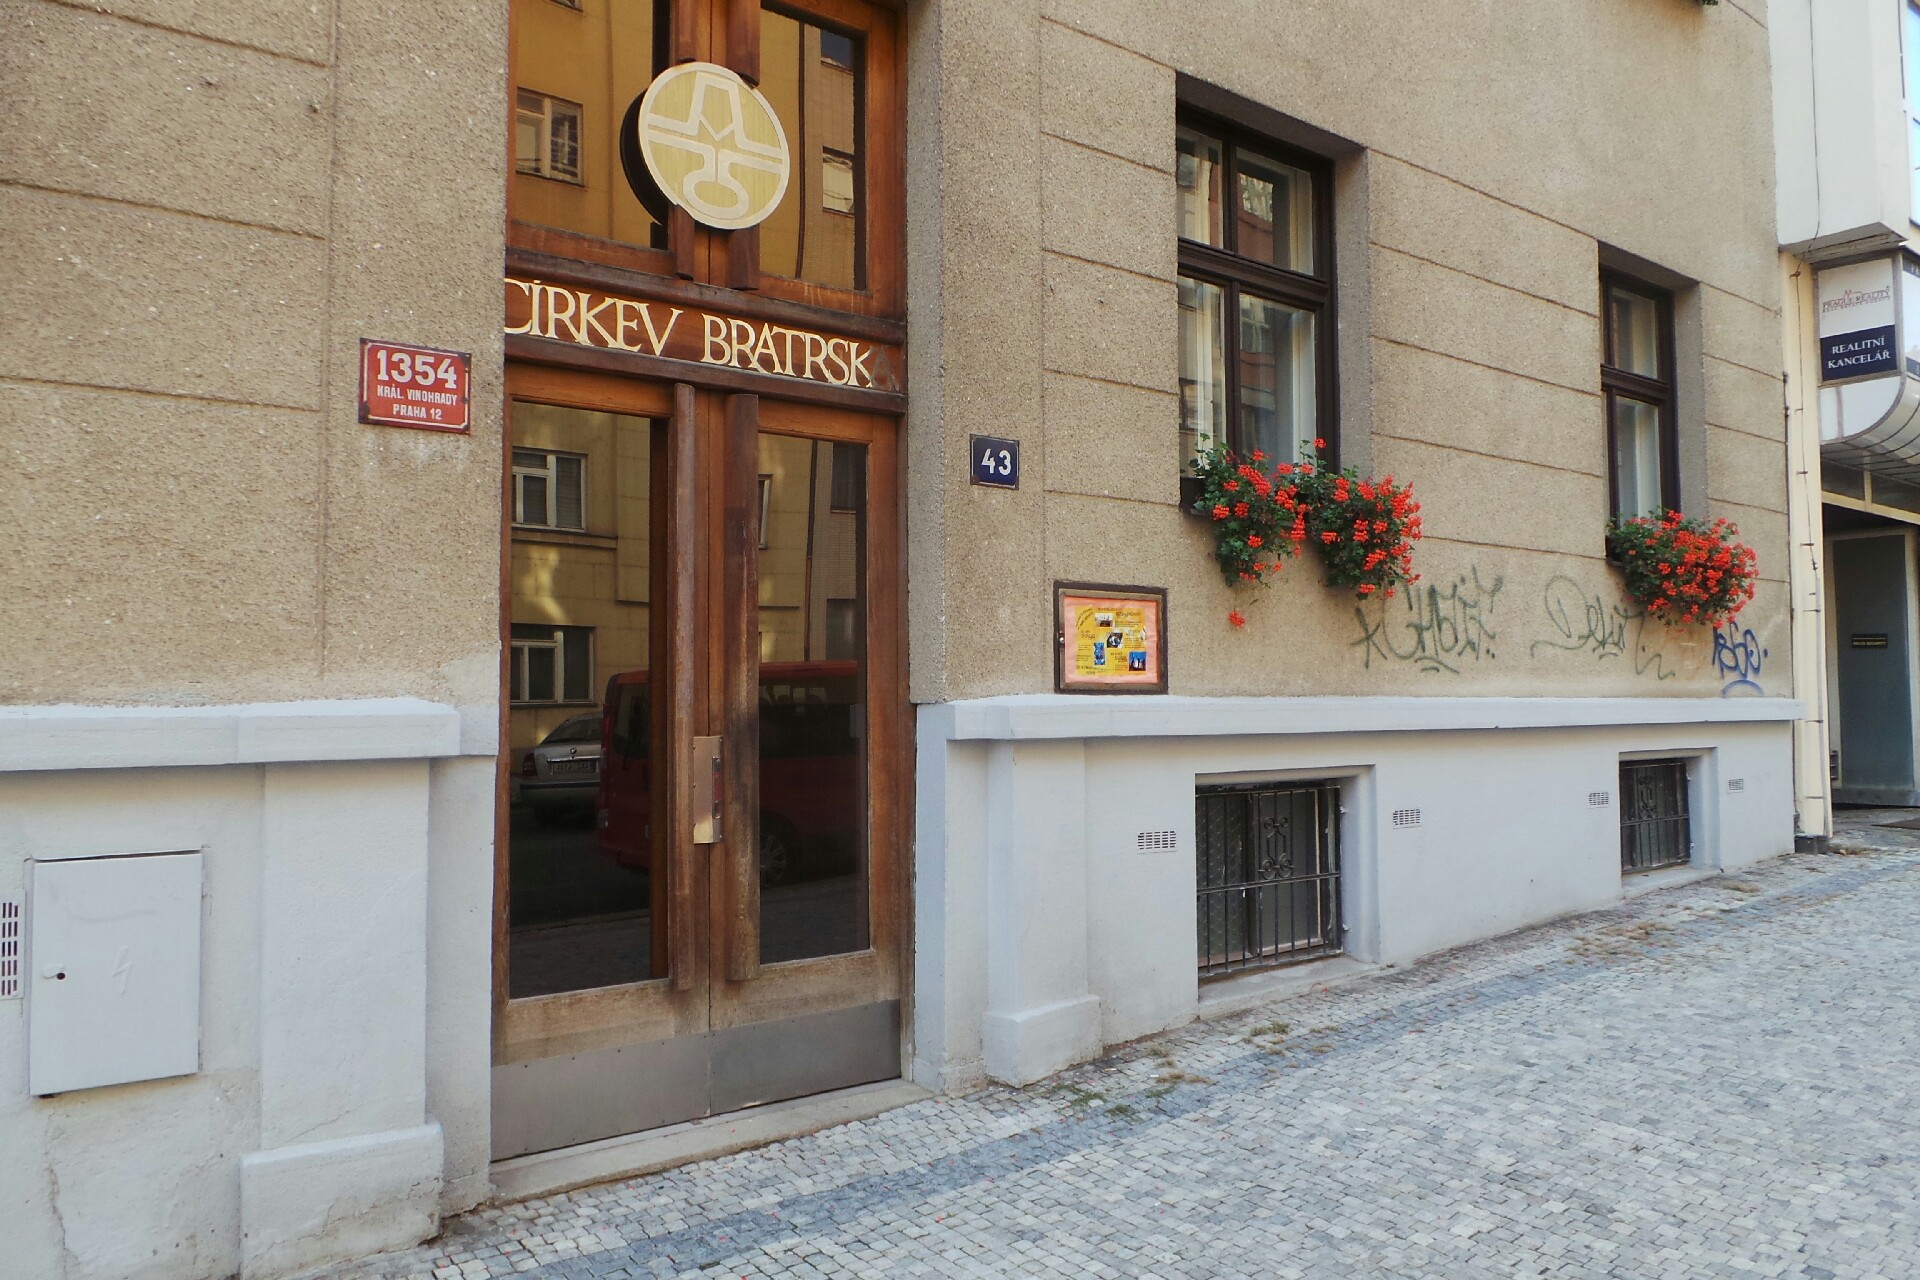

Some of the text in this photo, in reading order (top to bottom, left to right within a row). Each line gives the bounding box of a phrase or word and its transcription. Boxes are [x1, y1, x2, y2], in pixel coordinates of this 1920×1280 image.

[1832, 335, 1885, 354] REALITNÍ
[1828, 349, 1891, 368] KANCELÁŘ
[377, 350, 457, 389] 1354
[407, 389, 457, 406] VINOHRADY
[393, 404, 442, 420] PRAHA 12
[981, 448, 1011, 476] 43
